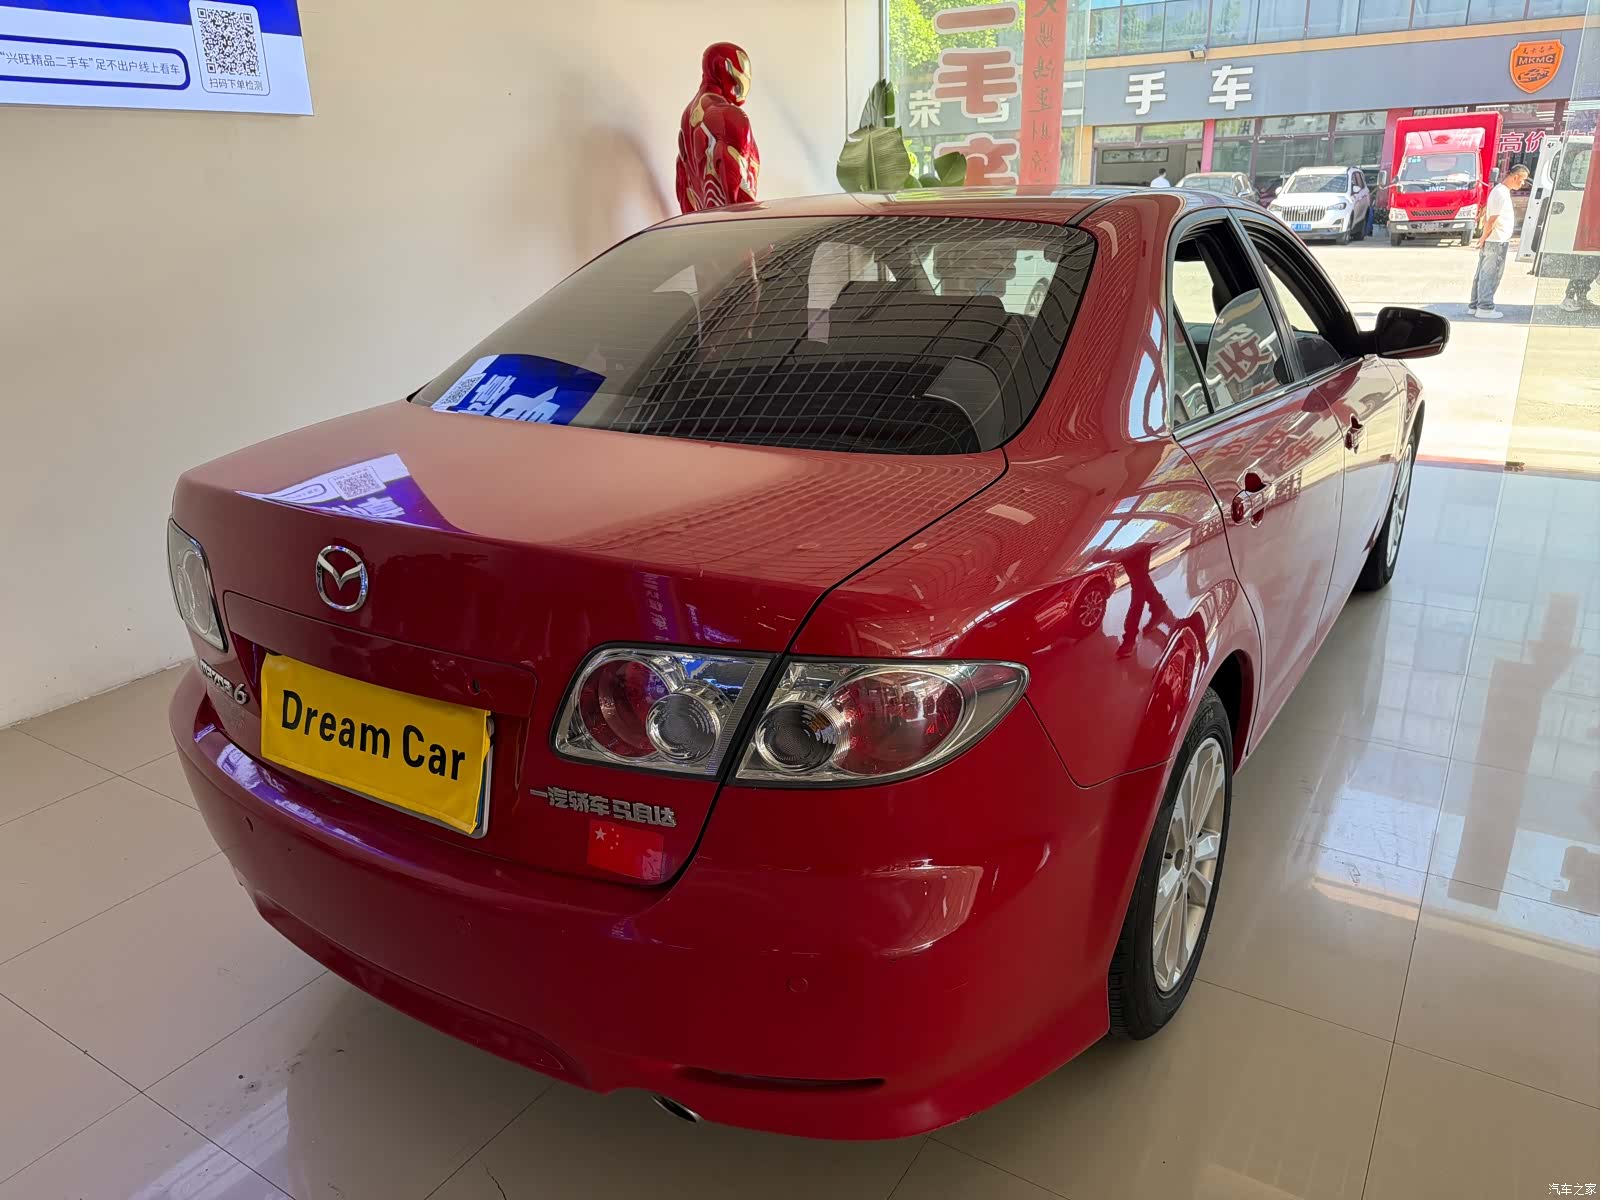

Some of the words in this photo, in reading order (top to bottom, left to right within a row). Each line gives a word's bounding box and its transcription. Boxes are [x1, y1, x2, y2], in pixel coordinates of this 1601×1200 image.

[208, 77, 264, 91] 扫码下单检测
[281, 689, 391, 760] Dream
[402, 724, 466, 781] Car
[529, 786, 610, 816] 一汽轿车
